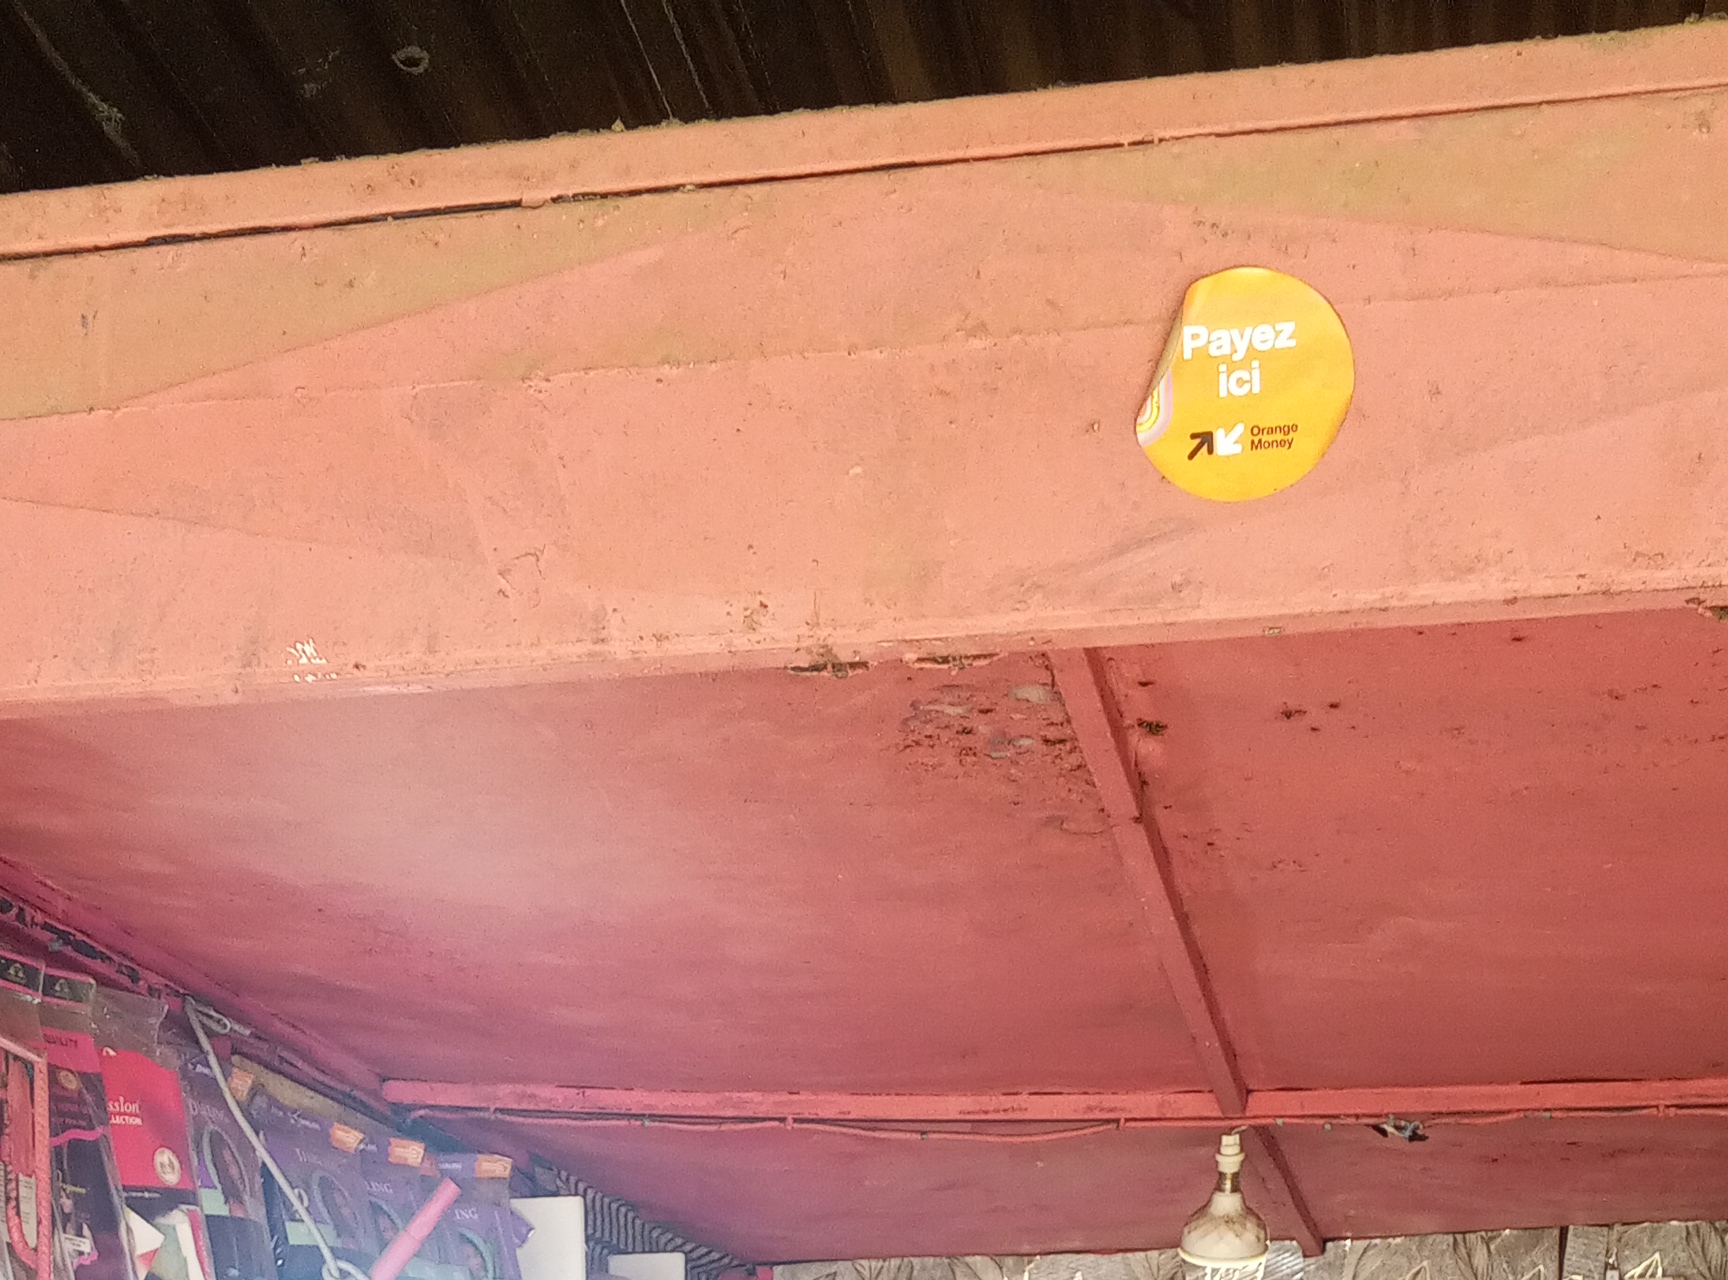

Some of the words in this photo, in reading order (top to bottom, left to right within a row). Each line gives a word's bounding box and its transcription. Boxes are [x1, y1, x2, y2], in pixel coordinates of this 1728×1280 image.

[1182, 320, 1297, 362] Payez
[1218, 359, 1261, 398] ici
[1249, 422, 1299, 438] Orange
[1249, 435, 1295, 452] Money
